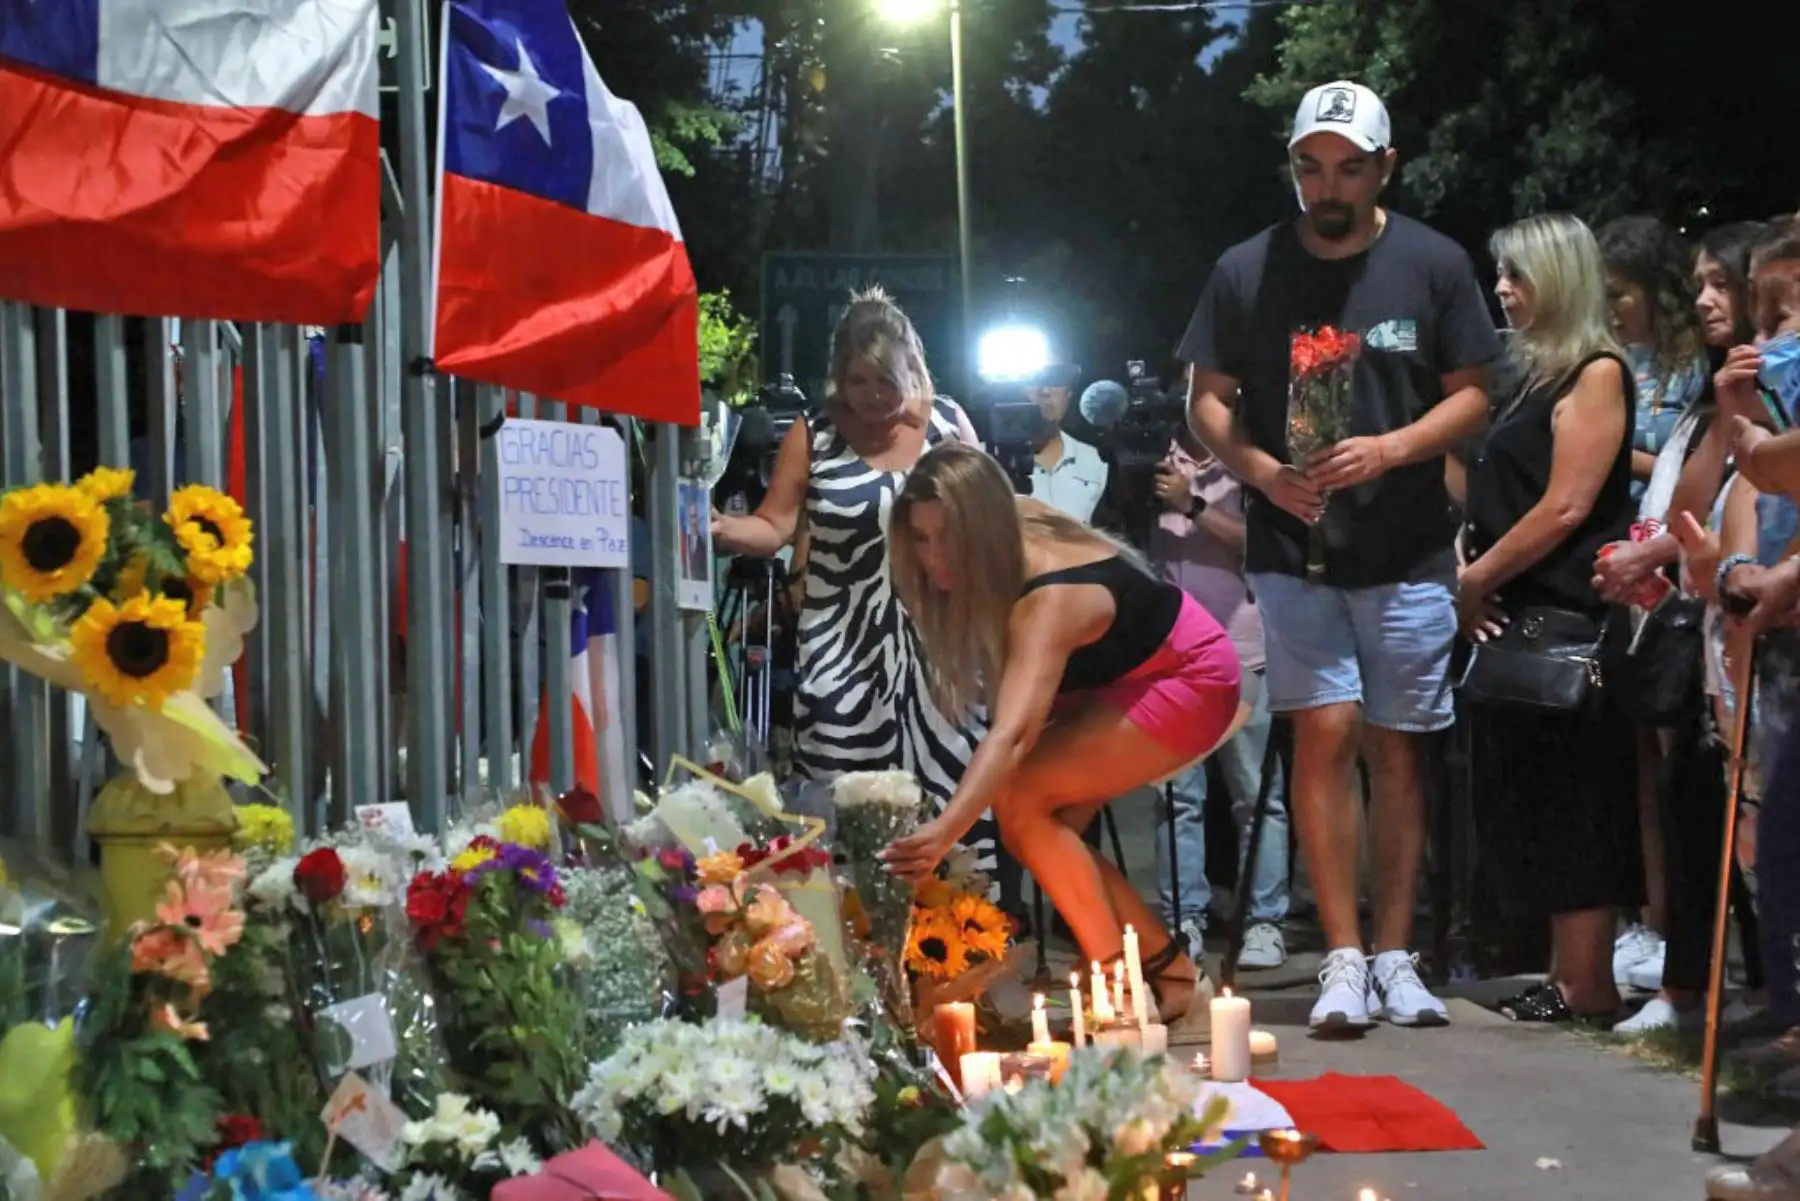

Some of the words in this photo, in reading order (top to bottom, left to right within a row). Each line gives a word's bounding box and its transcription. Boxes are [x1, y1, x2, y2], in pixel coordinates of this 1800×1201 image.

[500, 426, 598, 469] GRACIAS
[504, 476, 623, 517] PRESIDENTE
[596, 526, 627, 553] Paz
